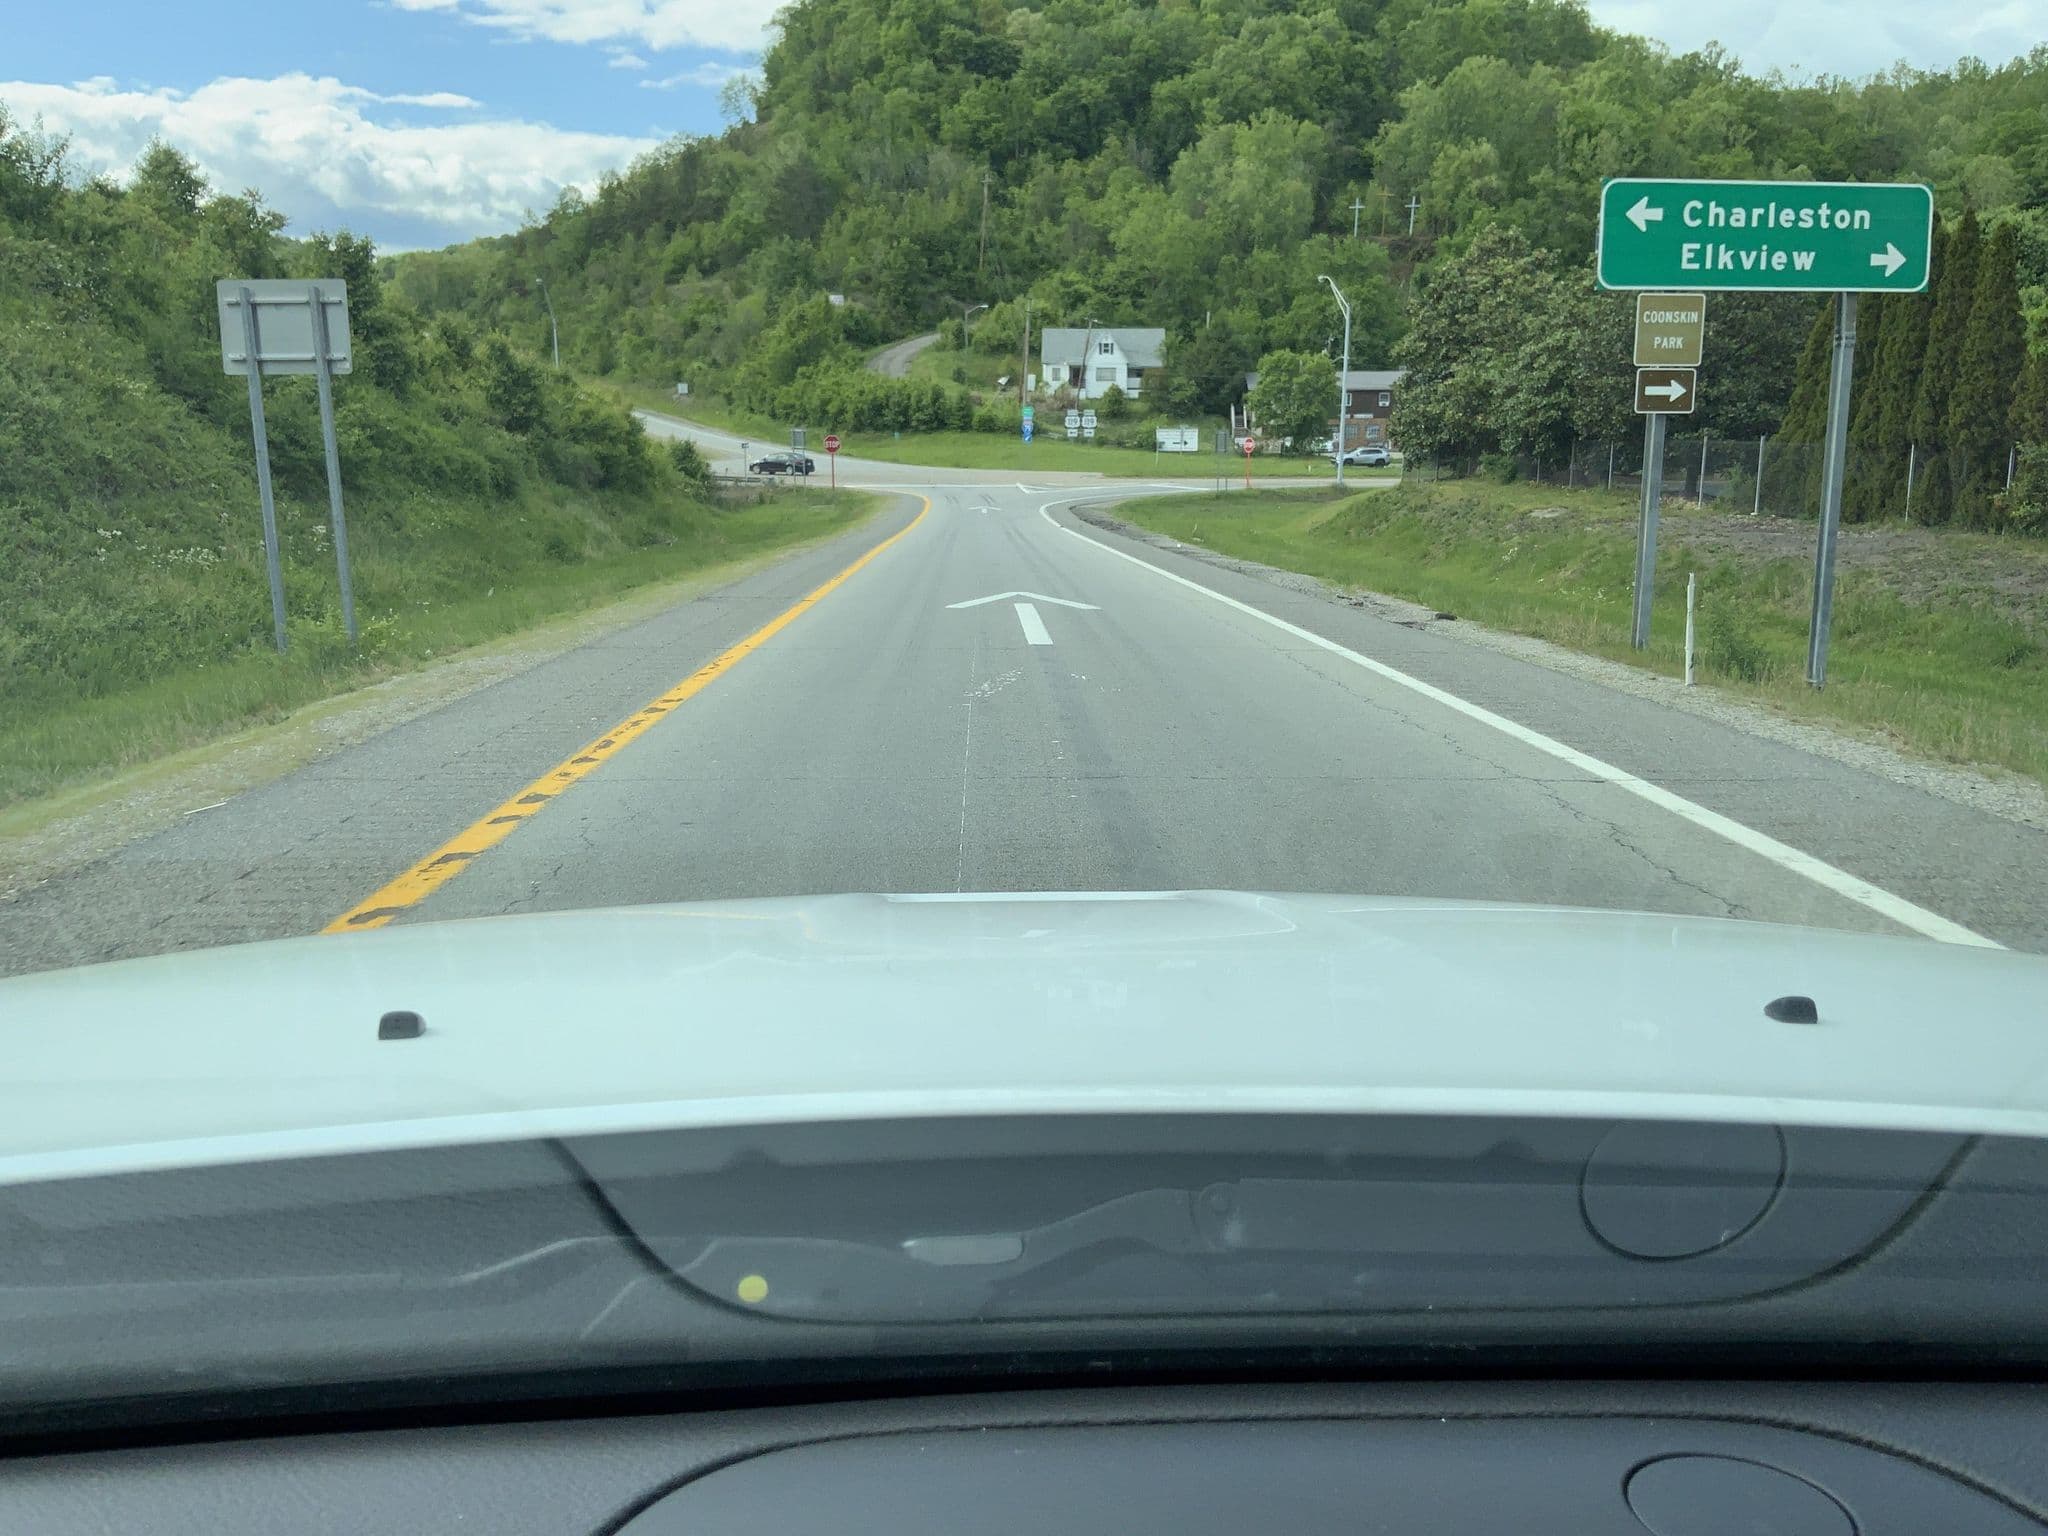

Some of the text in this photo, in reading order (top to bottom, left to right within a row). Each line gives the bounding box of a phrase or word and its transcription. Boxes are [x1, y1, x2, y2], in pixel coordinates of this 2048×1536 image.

[1683, 200, 1871, 230] Charleston
[1681, 243, 1816, 271] Elkview
[1643, 311, 1698, 324] COONSKIN
[1653, 336, 1684, 349] PARK
[825, 440, 840, 448] STOP
